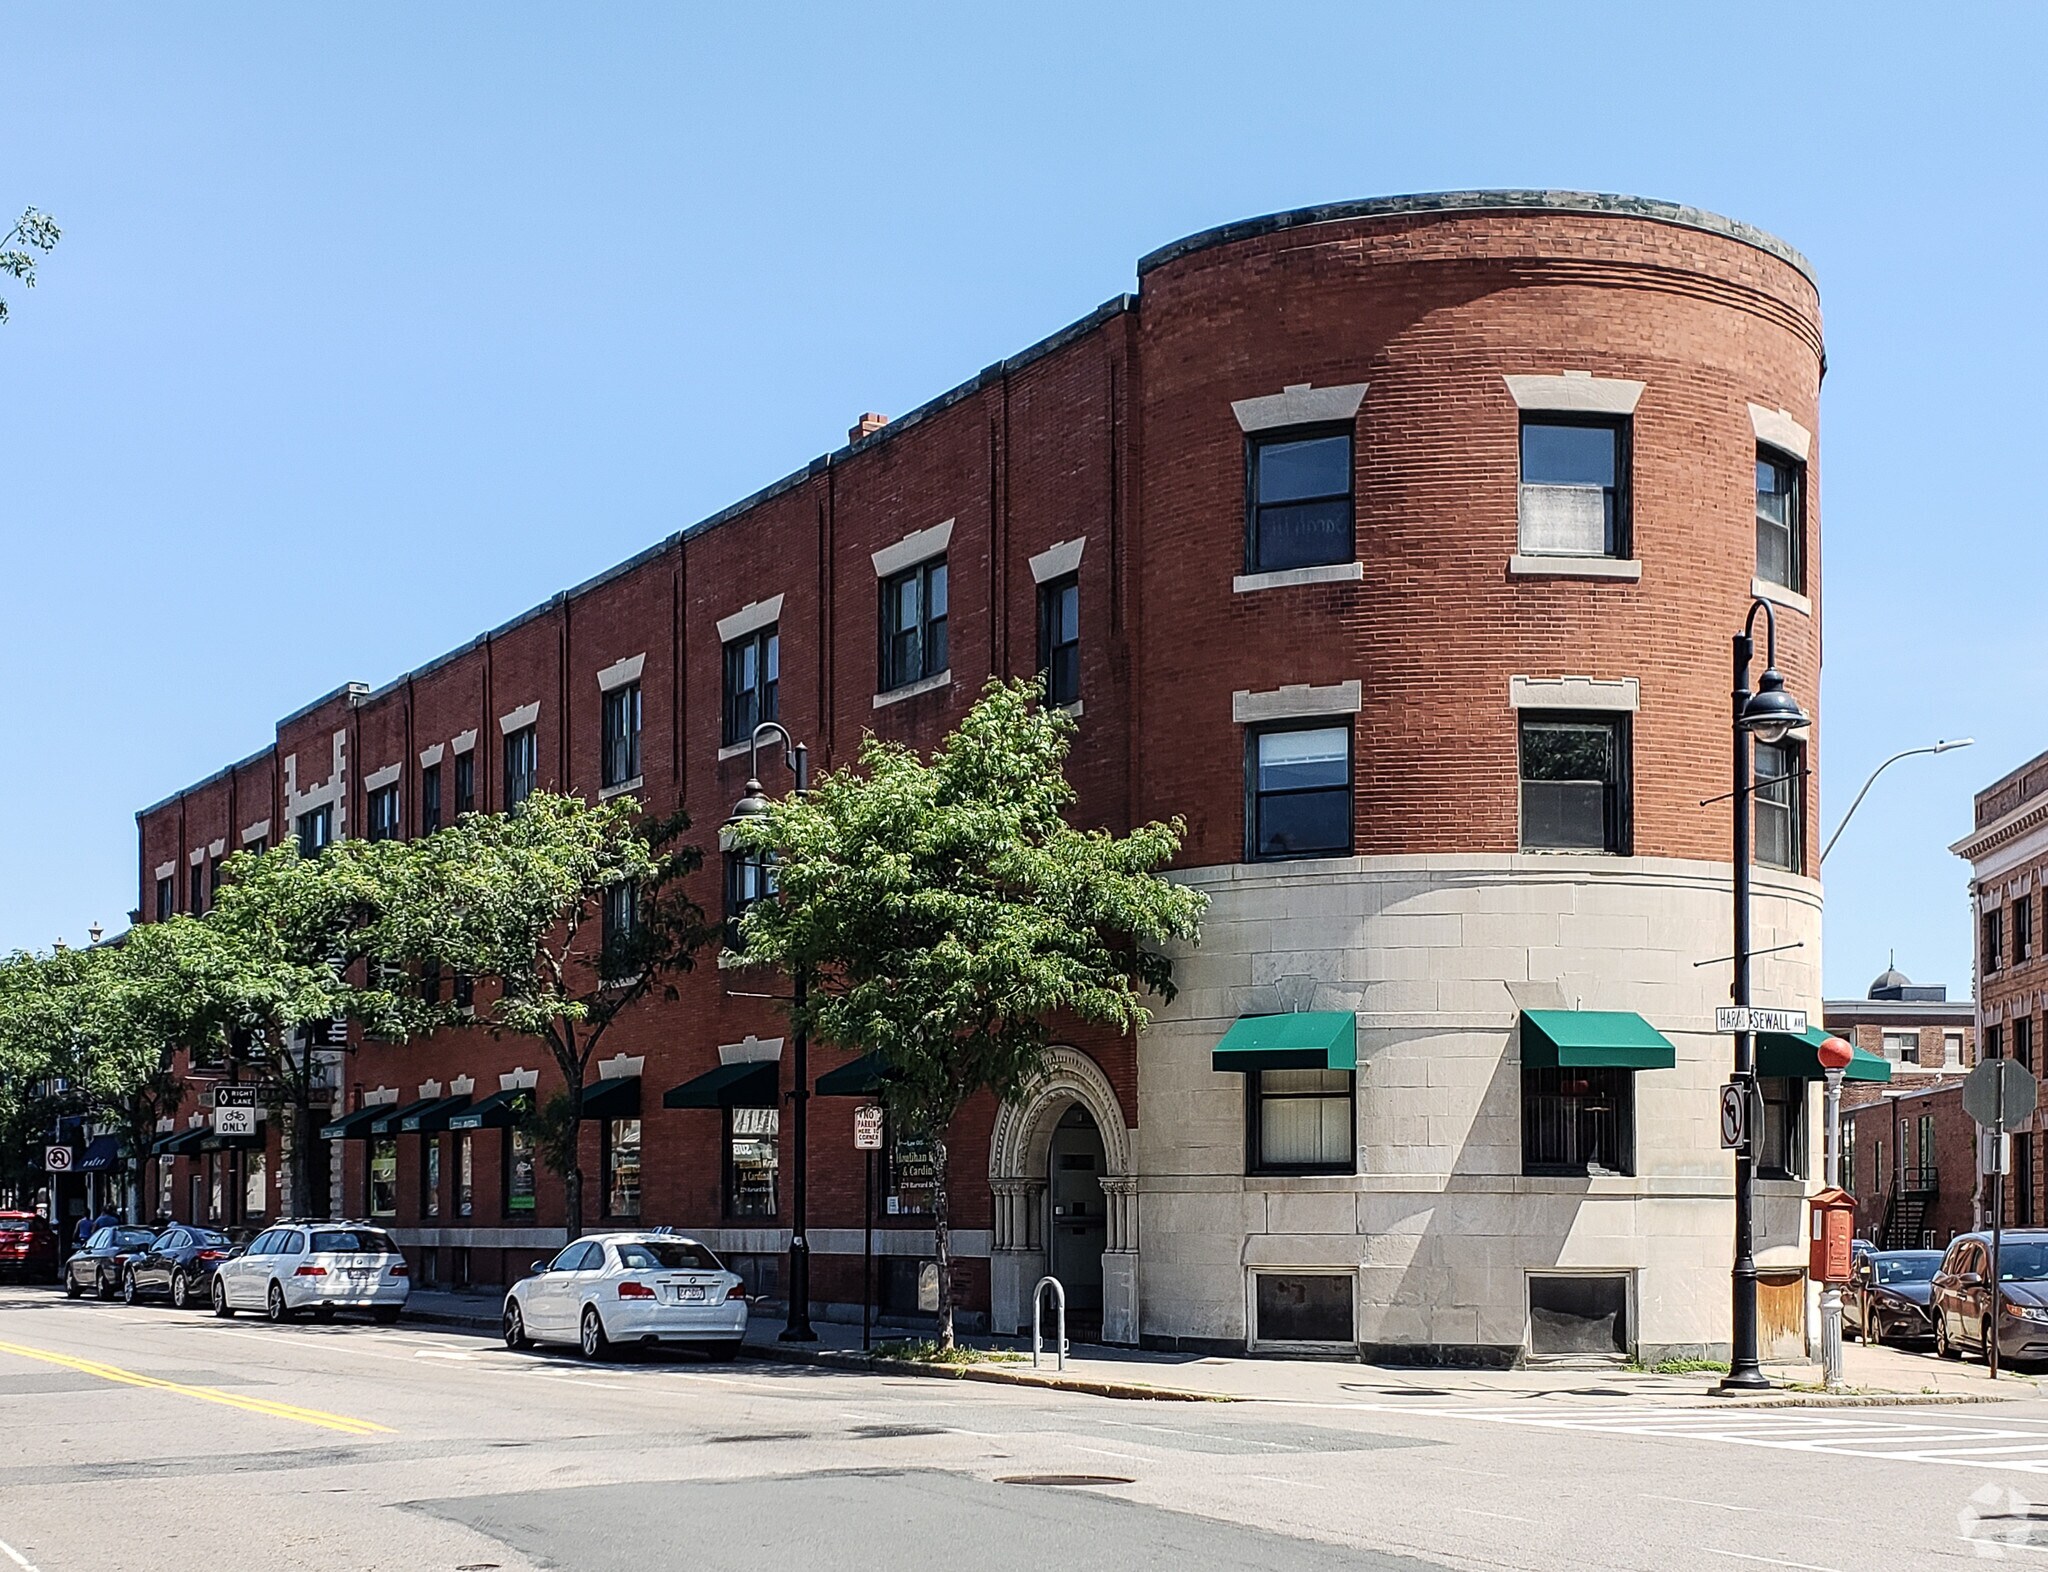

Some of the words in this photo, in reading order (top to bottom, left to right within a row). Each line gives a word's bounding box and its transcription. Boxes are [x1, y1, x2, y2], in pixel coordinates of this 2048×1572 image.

[1753, 1011, 1790, 1030] SEWALL
[864, 1110, 874, 1119] NO
[222, 1122, 248, 1132] ONLY
[909, 1165, 933, 1176] Cardin
